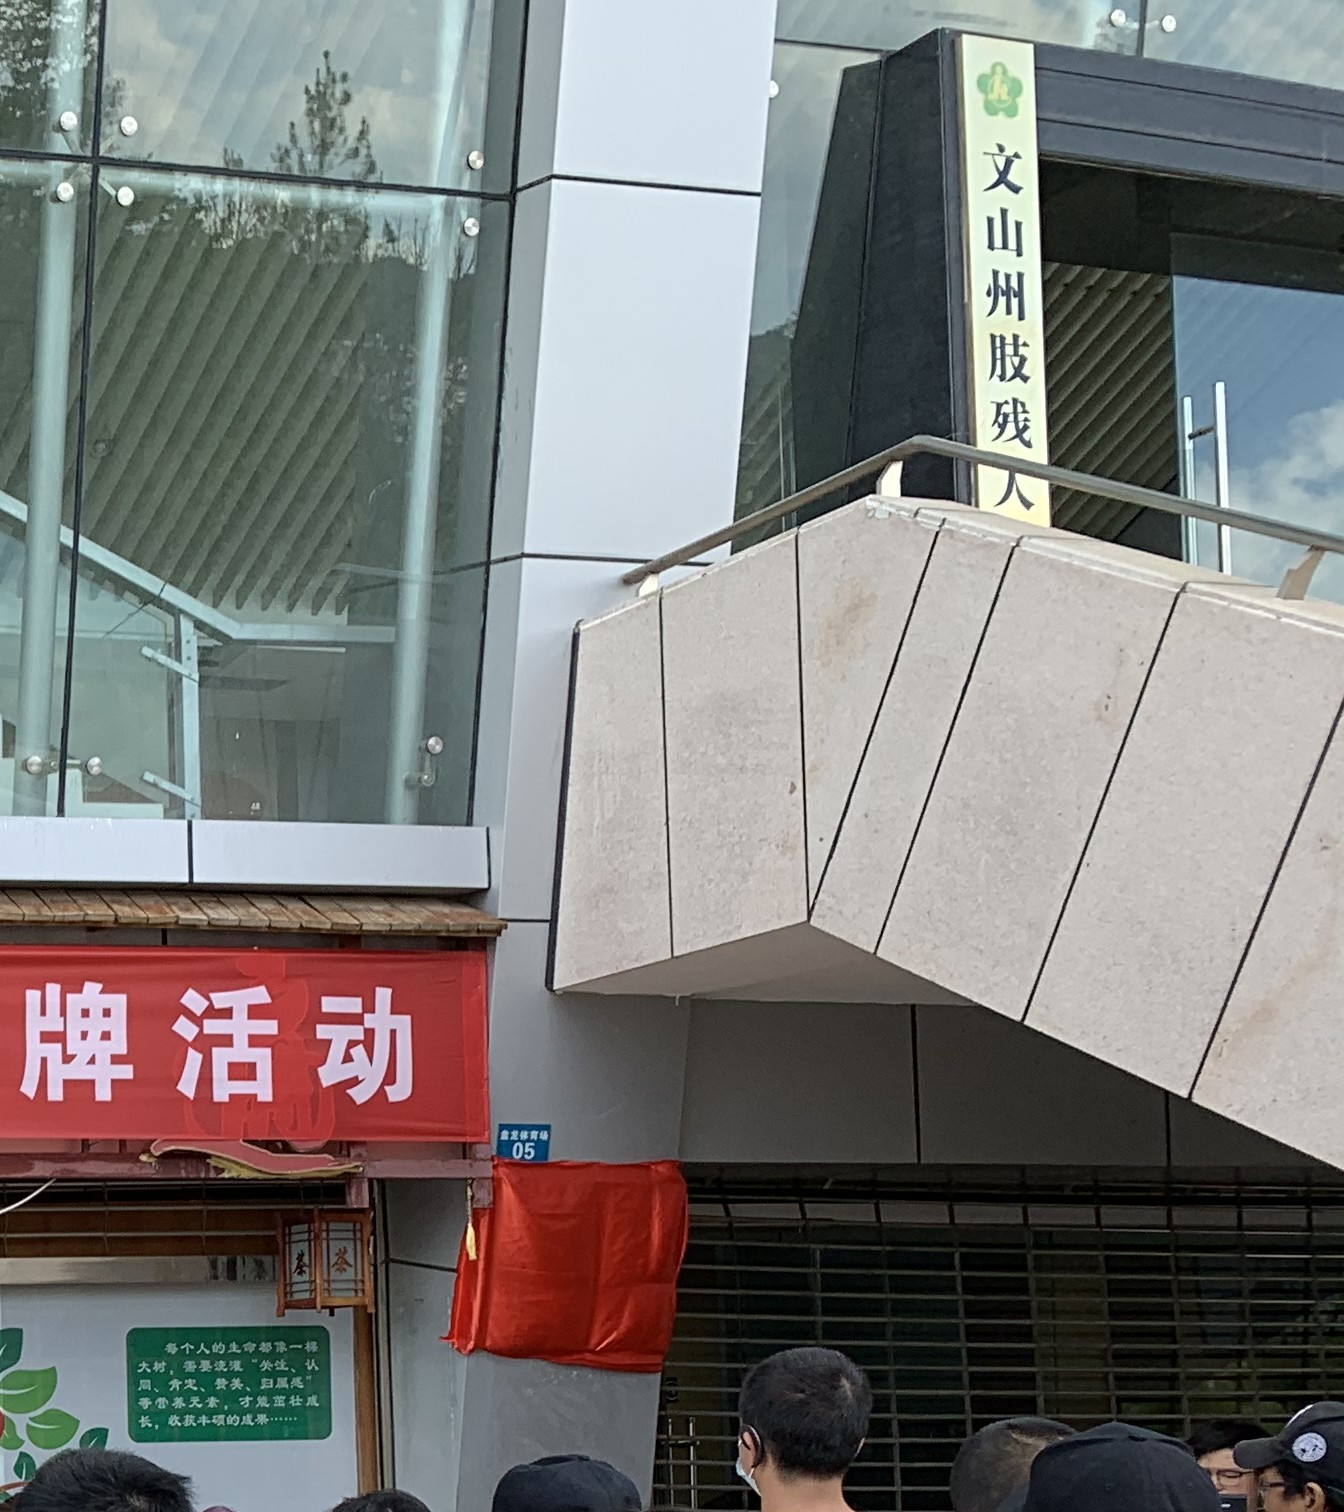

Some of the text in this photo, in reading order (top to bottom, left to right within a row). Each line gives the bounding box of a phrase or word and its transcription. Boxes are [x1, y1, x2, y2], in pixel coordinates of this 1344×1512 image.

[983, 144, 1035, 512] 文山州肢残人
[513, 1142, 535, 1160] 05
[331, 1246, 353, 1275] 茶
